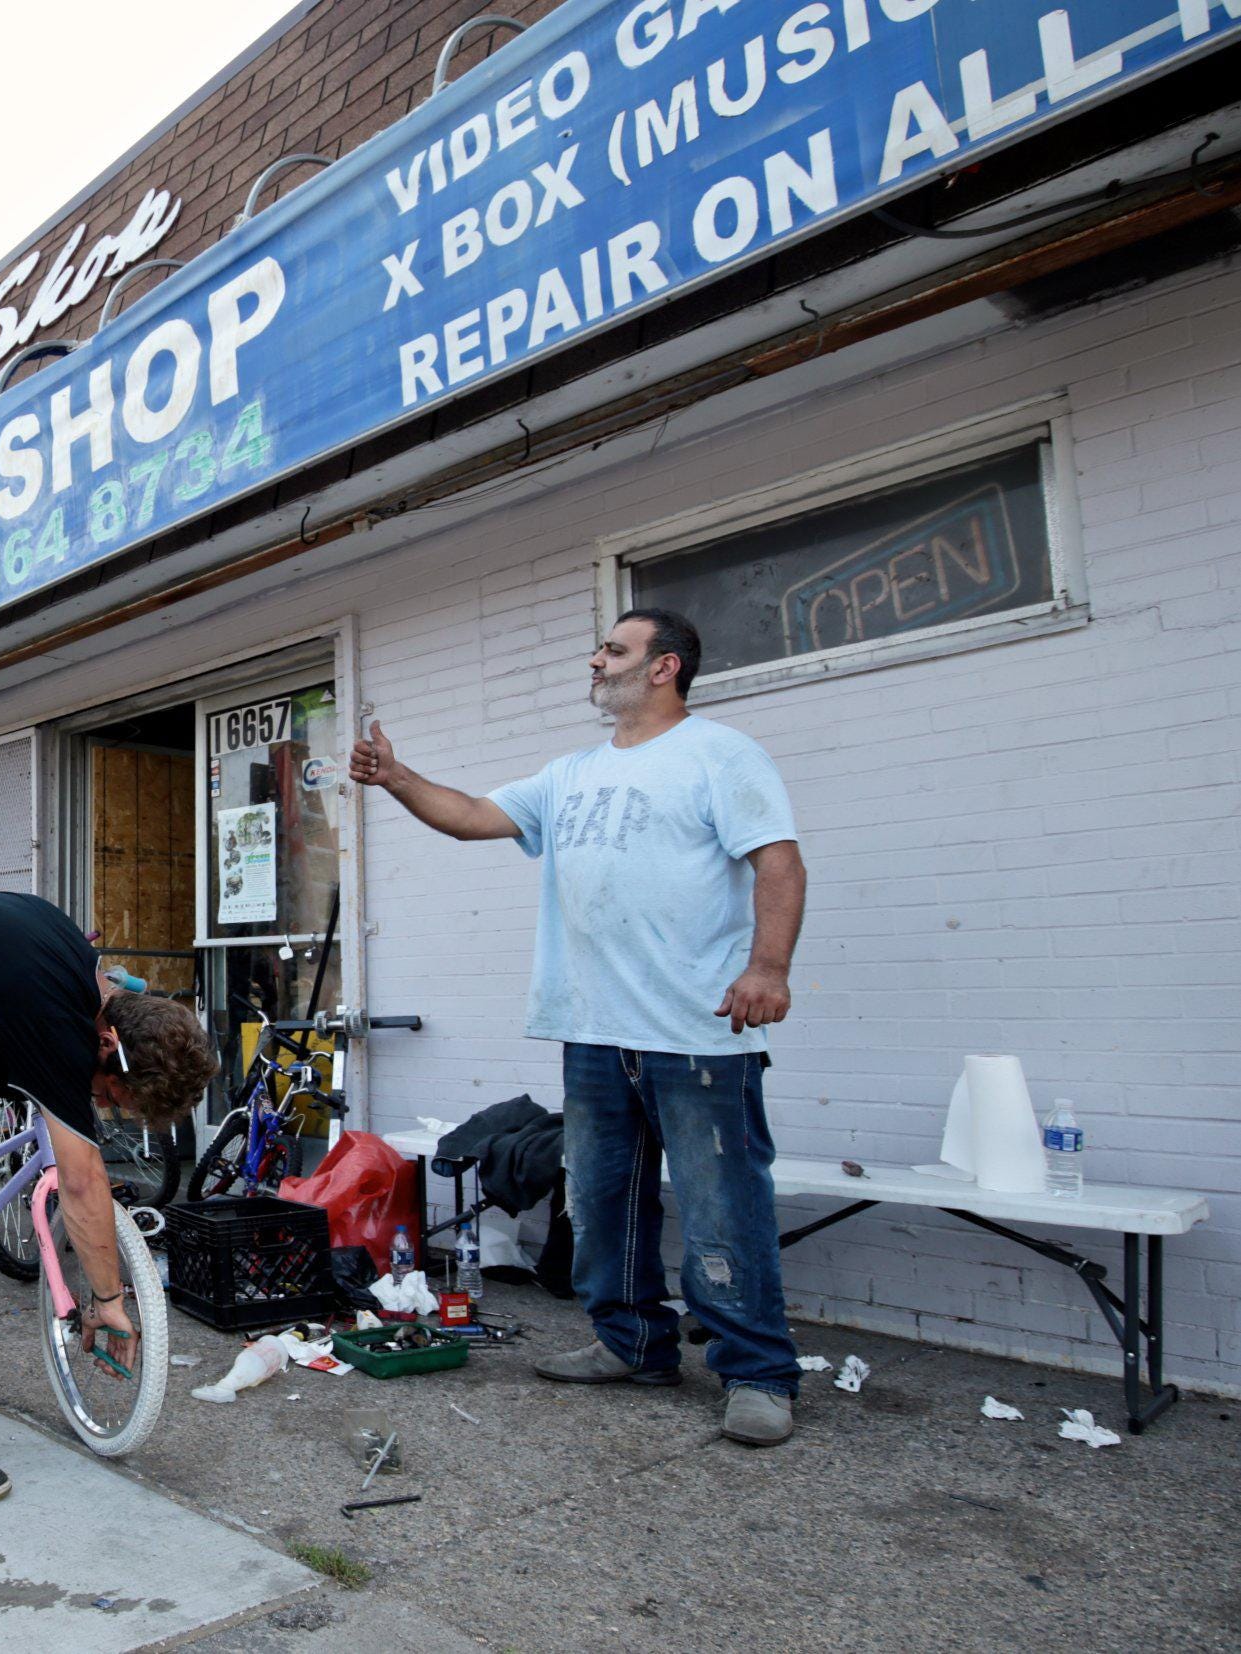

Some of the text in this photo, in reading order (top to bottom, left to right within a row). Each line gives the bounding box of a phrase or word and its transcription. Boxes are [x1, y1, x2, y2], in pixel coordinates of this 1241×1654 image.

[385, 51, 591, 216] VIDEO
[382, 238, 424, 312] X
[442, 145, 585, 278] BOX
[400, 8, 1123, 407] REPAIR ON ALL
[90, 399, 272, 544] 8734
[810, 516, 991, 650] OPEN
[214, 699, 291, 754] 16657
[554, 785, 653, 853] GAP
